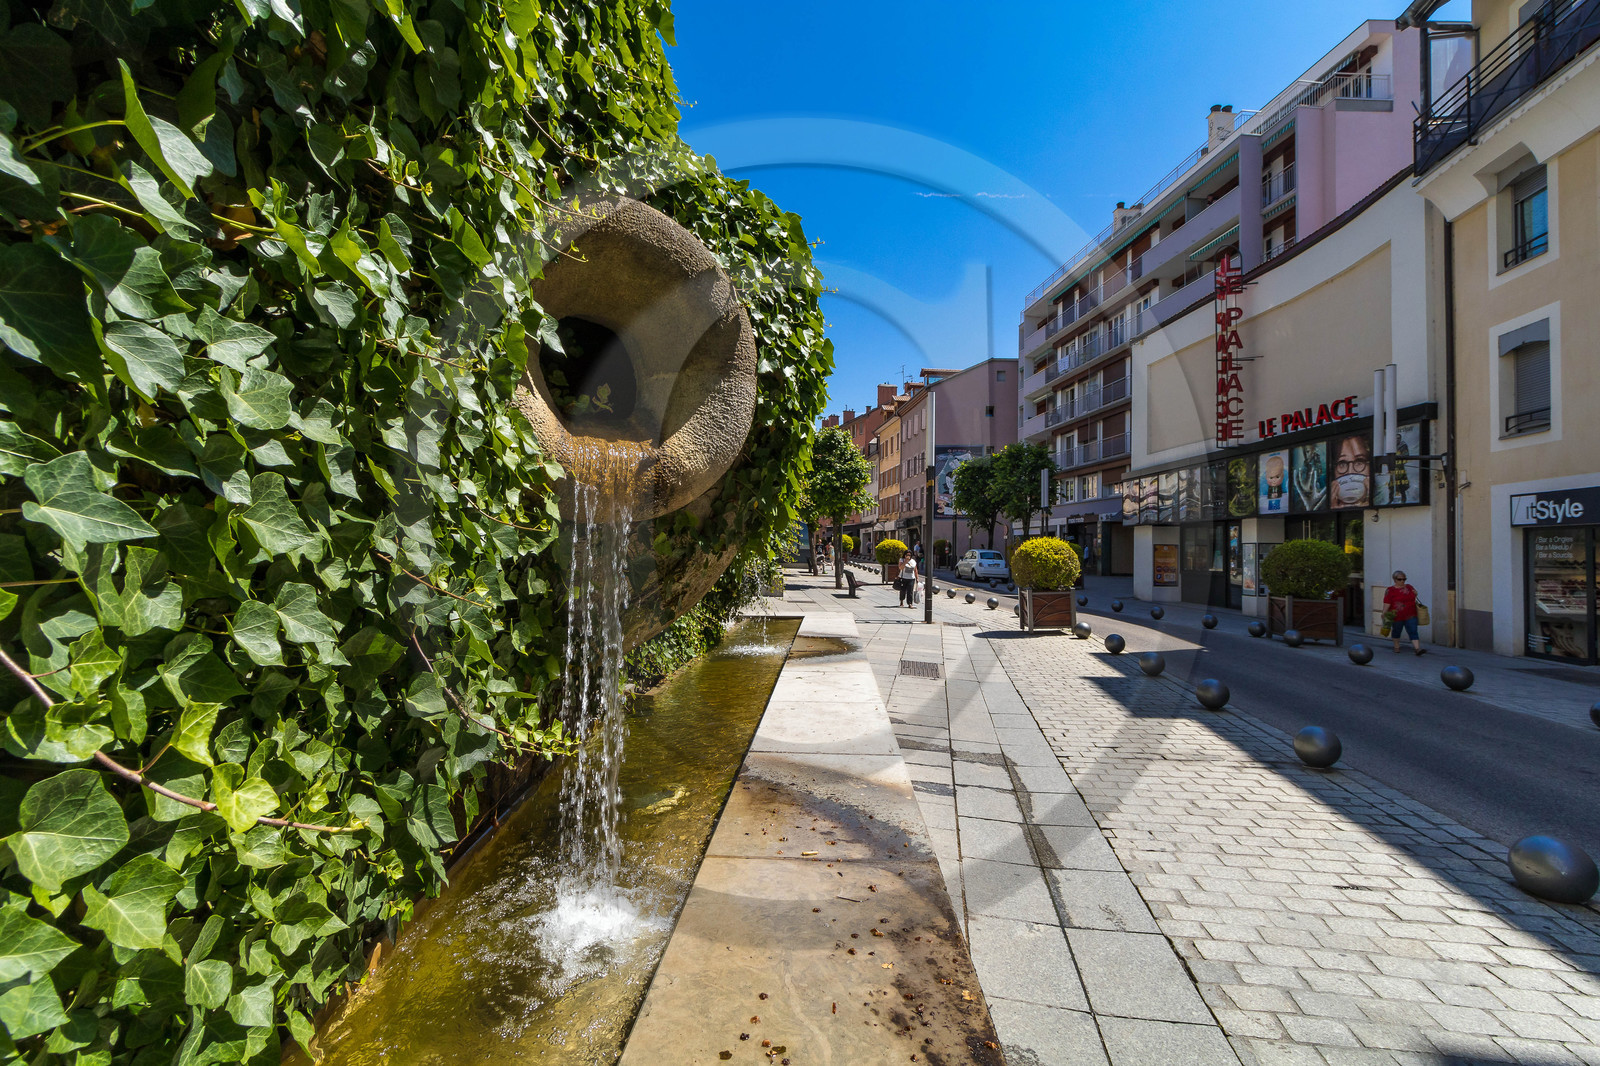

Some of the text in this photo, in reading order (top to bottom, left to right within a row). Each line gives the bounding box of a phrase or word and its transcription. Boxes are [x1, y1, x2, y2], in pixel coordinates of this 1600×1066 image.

[1226, 254, 1245, 439] LE PALACE
[1259, 395, 1359, 438] LE PALACE
